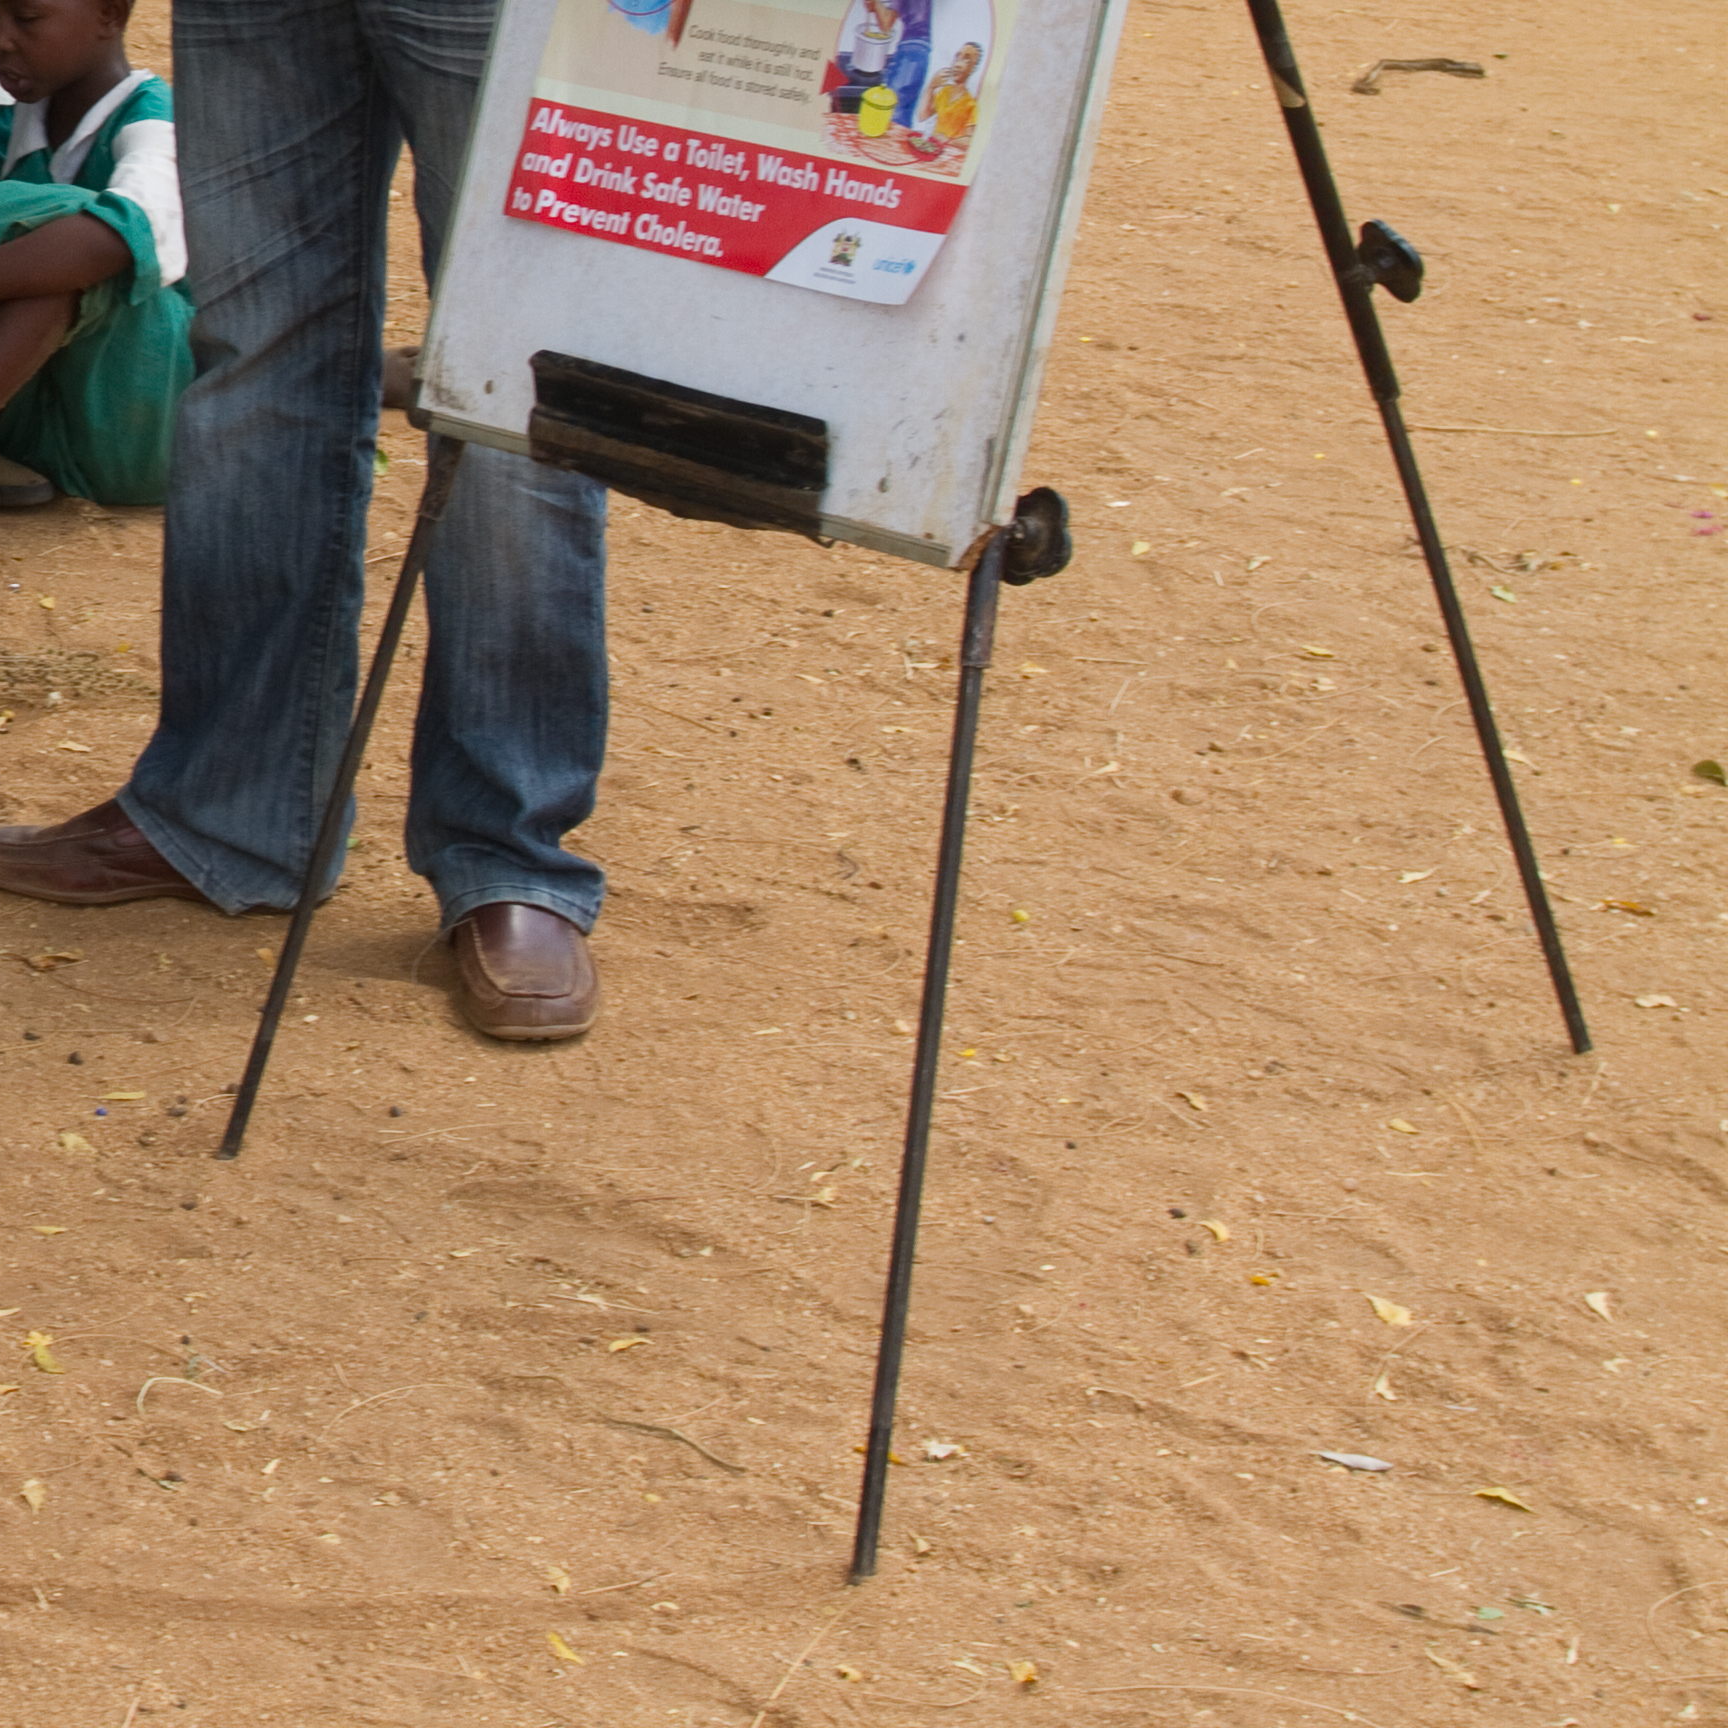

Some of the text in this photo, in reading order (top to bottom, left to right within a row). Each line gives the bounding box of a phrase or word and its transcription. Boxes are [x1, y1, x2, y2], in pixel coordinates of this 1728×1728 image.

[688, 24, 823, 61] Cook food thoroughly and
[698, 51, 814, 81] eat it while it is still hot.
[657, 61, 812, 106] Ensure all food is stored safely.
[529, 107, 902, 208] Always Use a Toilet, Wash Hands
[521, 152, 766, 222] and Drink Safe Water
[512, 186, 724, 258] to Prevent Cholera.
